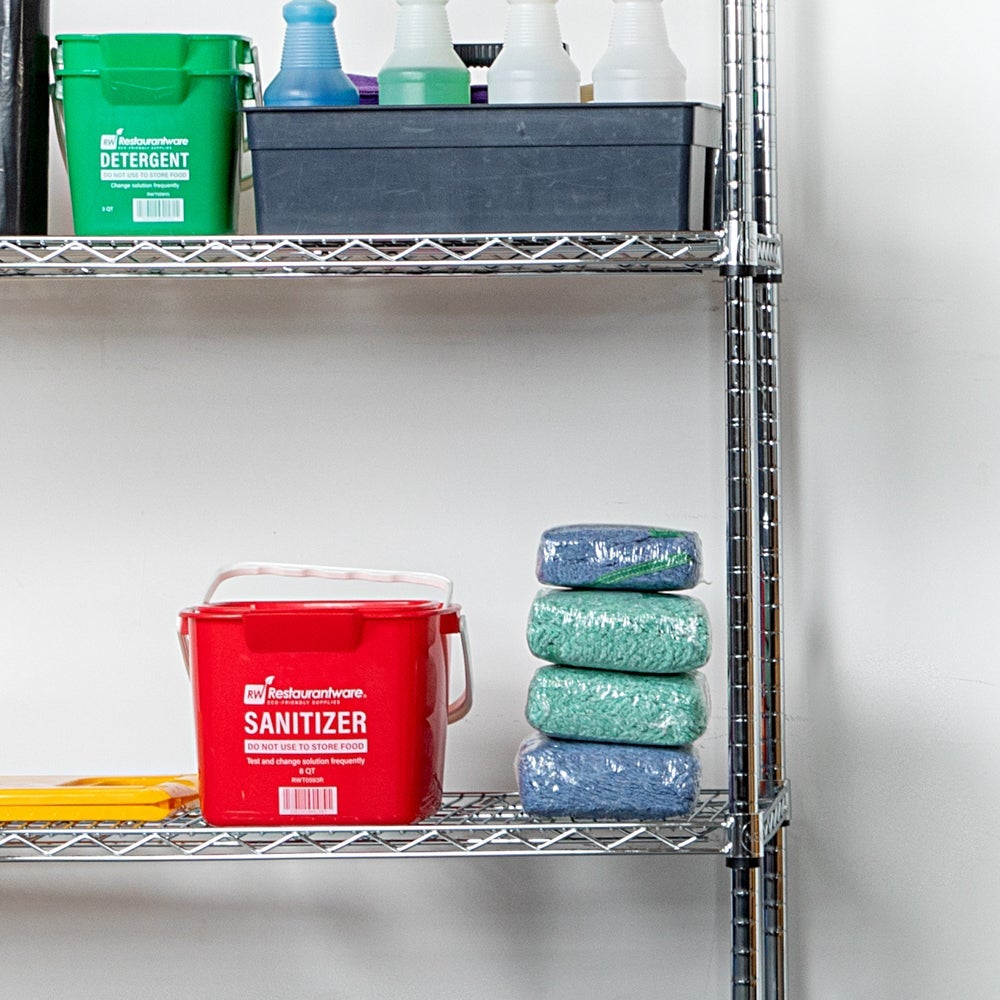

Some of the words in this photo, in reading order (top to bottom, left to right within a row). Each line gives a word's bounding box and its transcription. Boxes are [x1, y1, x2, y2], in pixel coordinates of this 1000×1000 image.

[118, 136, 189, 145] Restaurantware
[100, 152, 189, 168] DETERGENT
[244, 711, 367, 734] SANITIZER
[261, 743, 279, 751] NOT
[299, 743, 310, 751] TO
[340, 742, 365, 750] FOOD
[246, 757, 261, 765] Test
[261, 757, 275, 765] and
[275, 757, 301, 767] change
[302, 757, 330, 765] solution
[330, 756, 366, 766] frequently
[305, 767, 316, 775] QT
